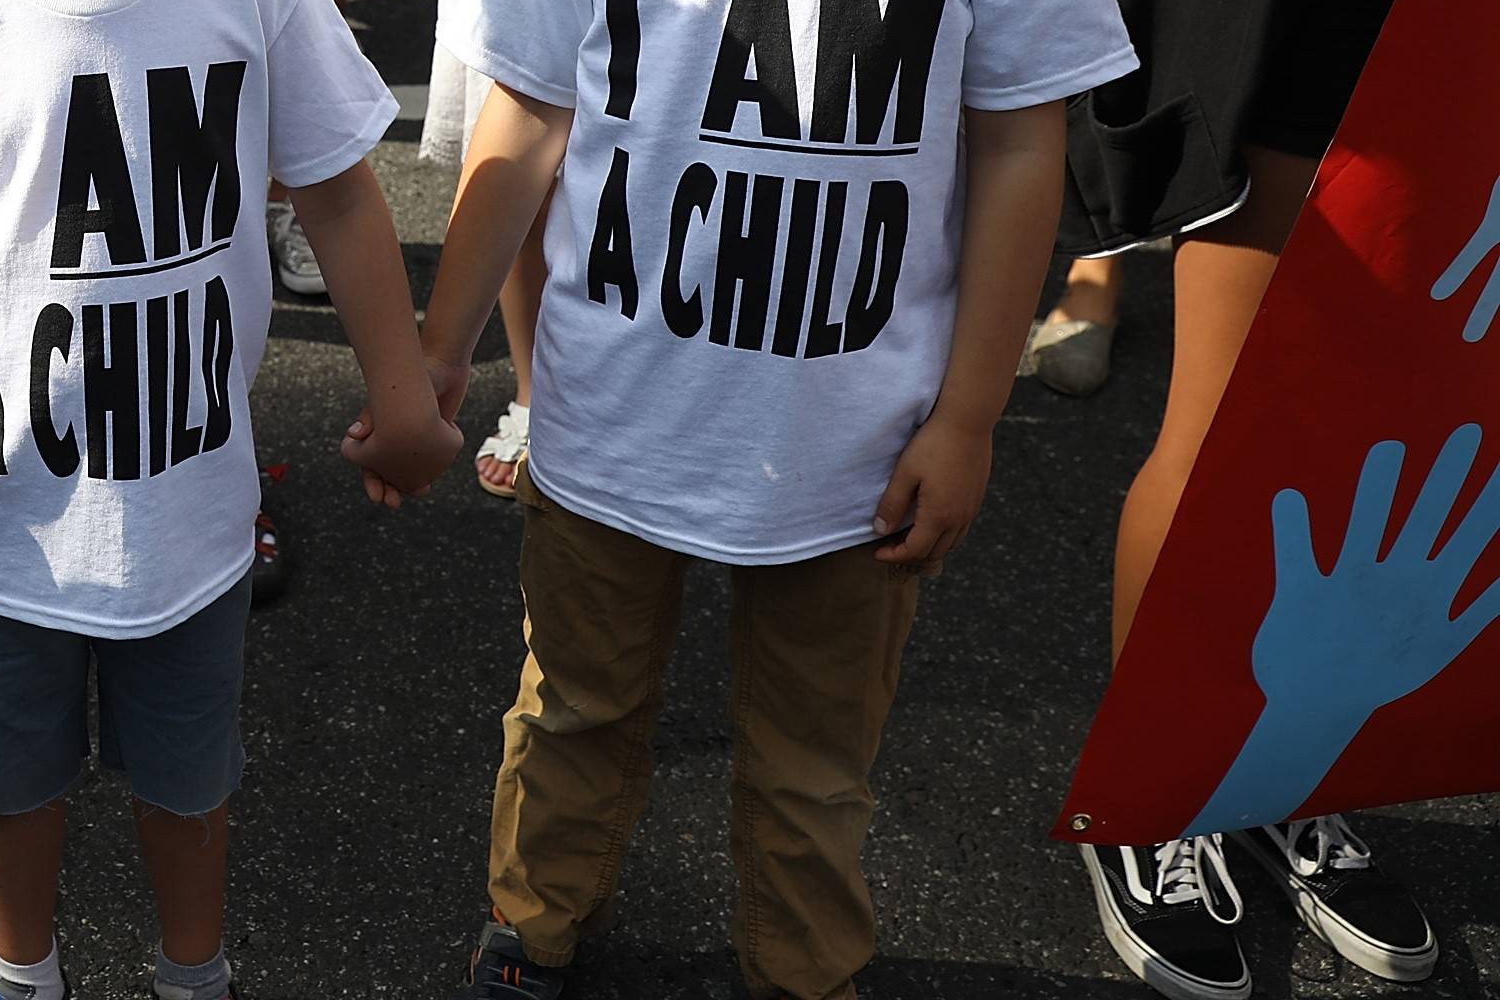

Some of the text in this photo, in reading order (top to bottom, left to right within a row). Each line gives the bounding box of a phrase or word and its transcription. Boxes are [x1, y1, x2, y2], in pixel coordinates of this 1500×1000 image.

[49, 60, 248, 269] AM
[587, 146, 910, 360] A CHILD
[29, 274, 235, 481] CHILD
